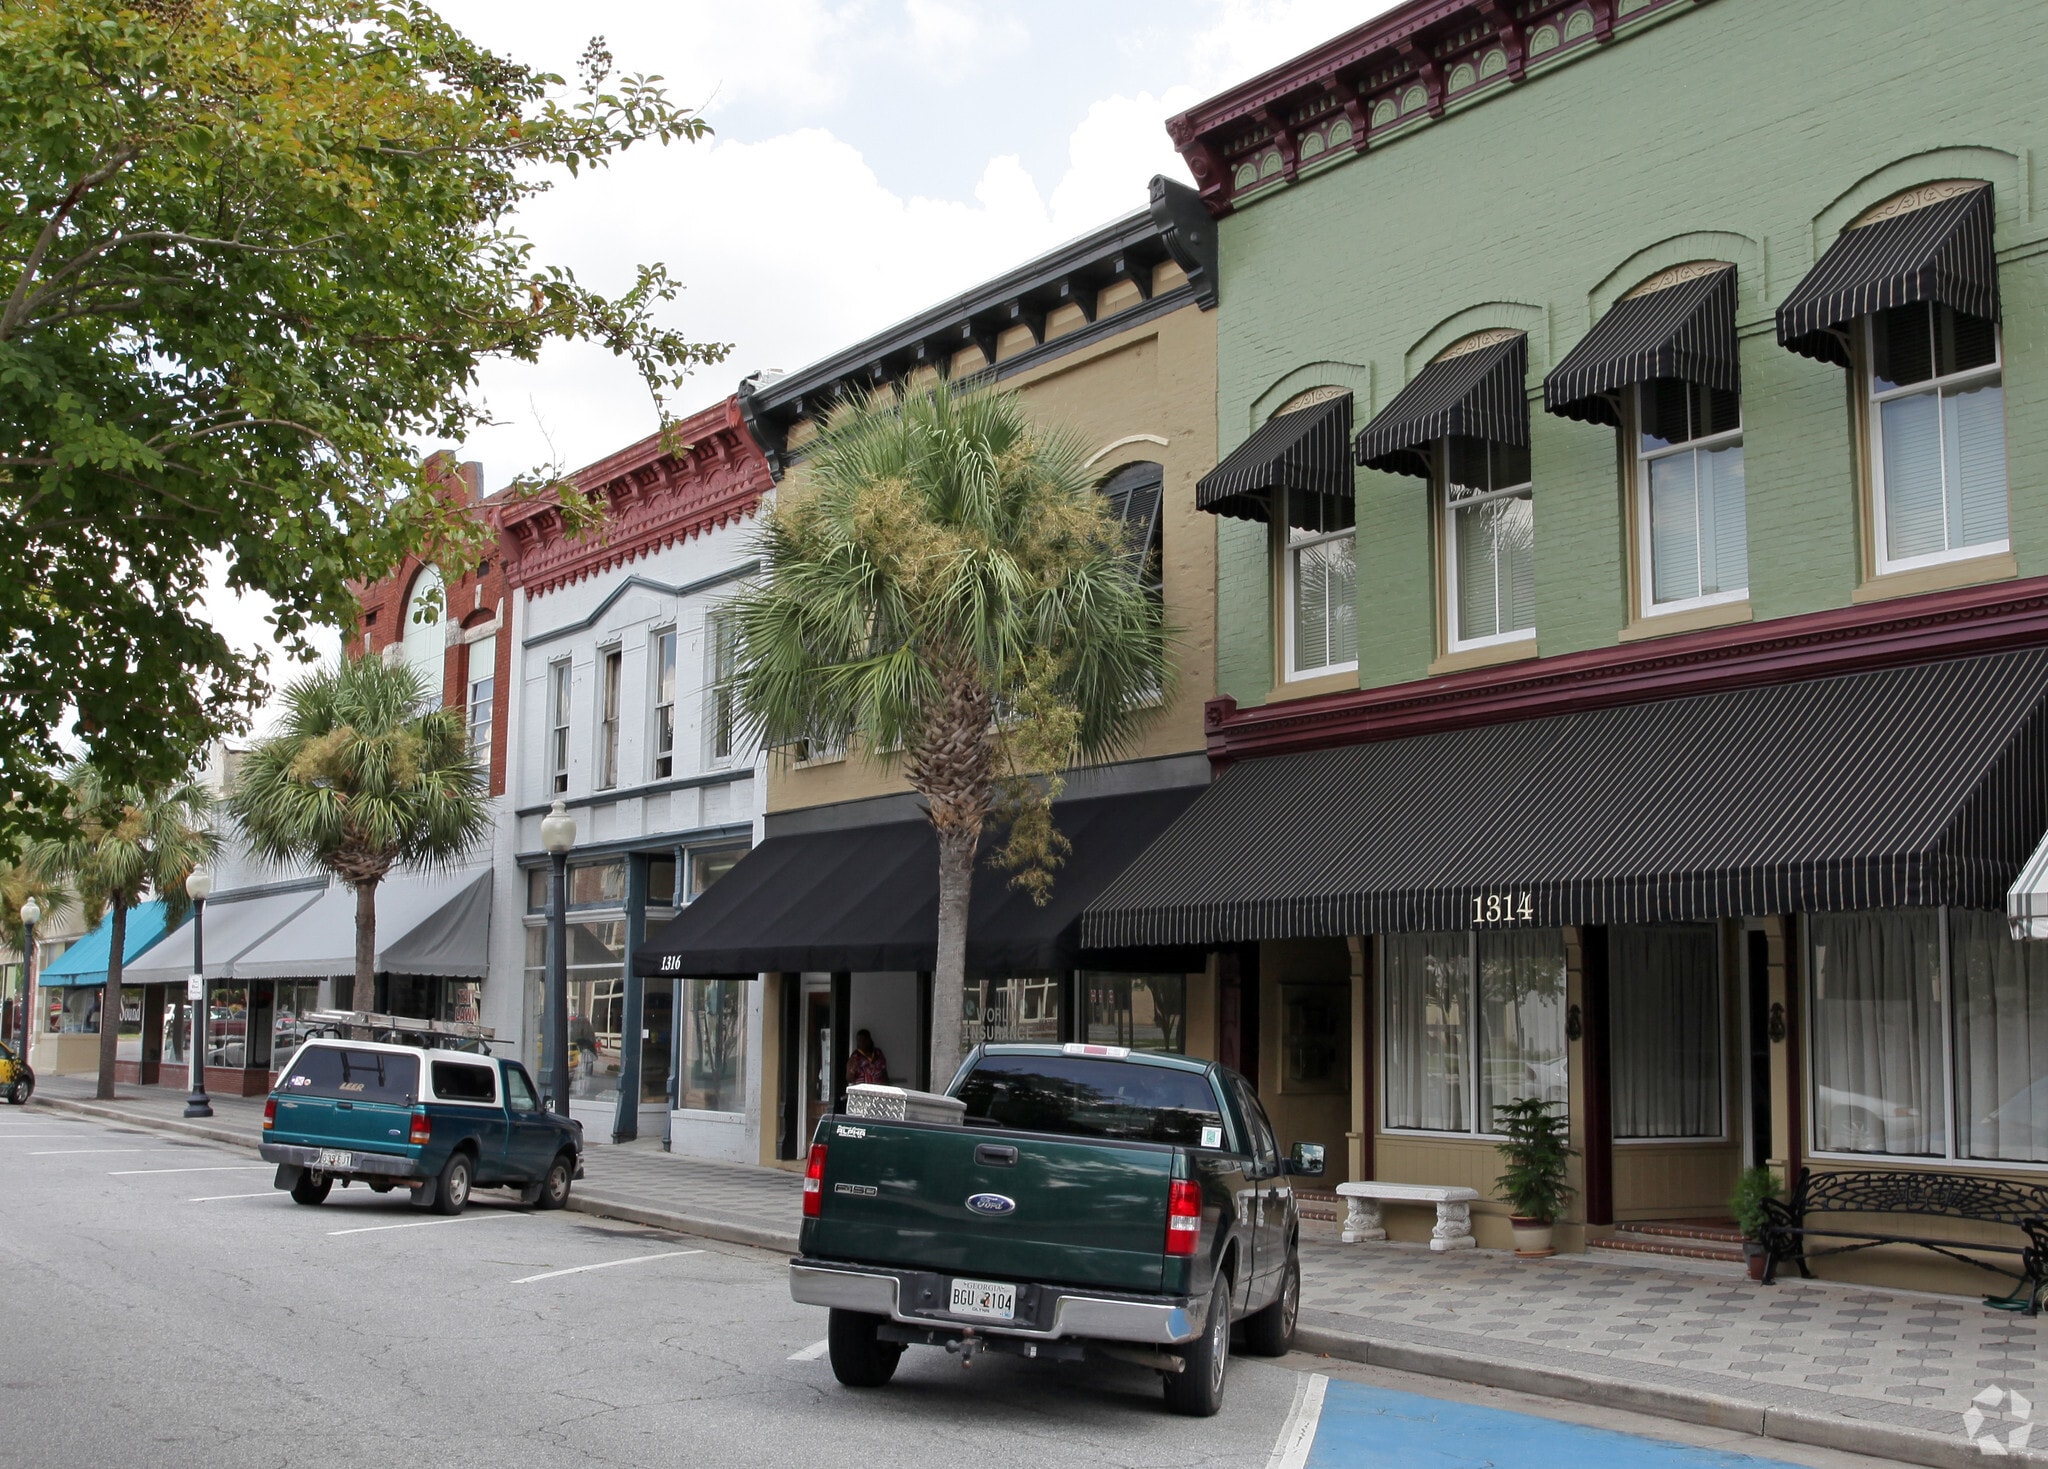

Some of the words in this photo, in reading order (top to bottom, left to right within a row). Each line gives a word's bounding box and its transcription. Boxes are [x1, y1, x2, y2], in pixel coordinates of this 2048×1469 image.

[1473, 891, 1534, 923] 1314
[661, 954, 682, 971] 1316
[119, 994, 141, 1022] Sound
[454, 1006, 479, 1024] LAWN
[962, 1025, 1033, 1041] INSURANCE
[339, 1081, 365, 1092] LEER
[836, 1126, 867, 1138] ALPHA
[976, 1196, 1004, 1210] Ford
[966, 1281, 1002, 1292] GEORGIA
[953, 1288, 975, 1306] BGU
[983, 1292, 1013, 1311] 2104
